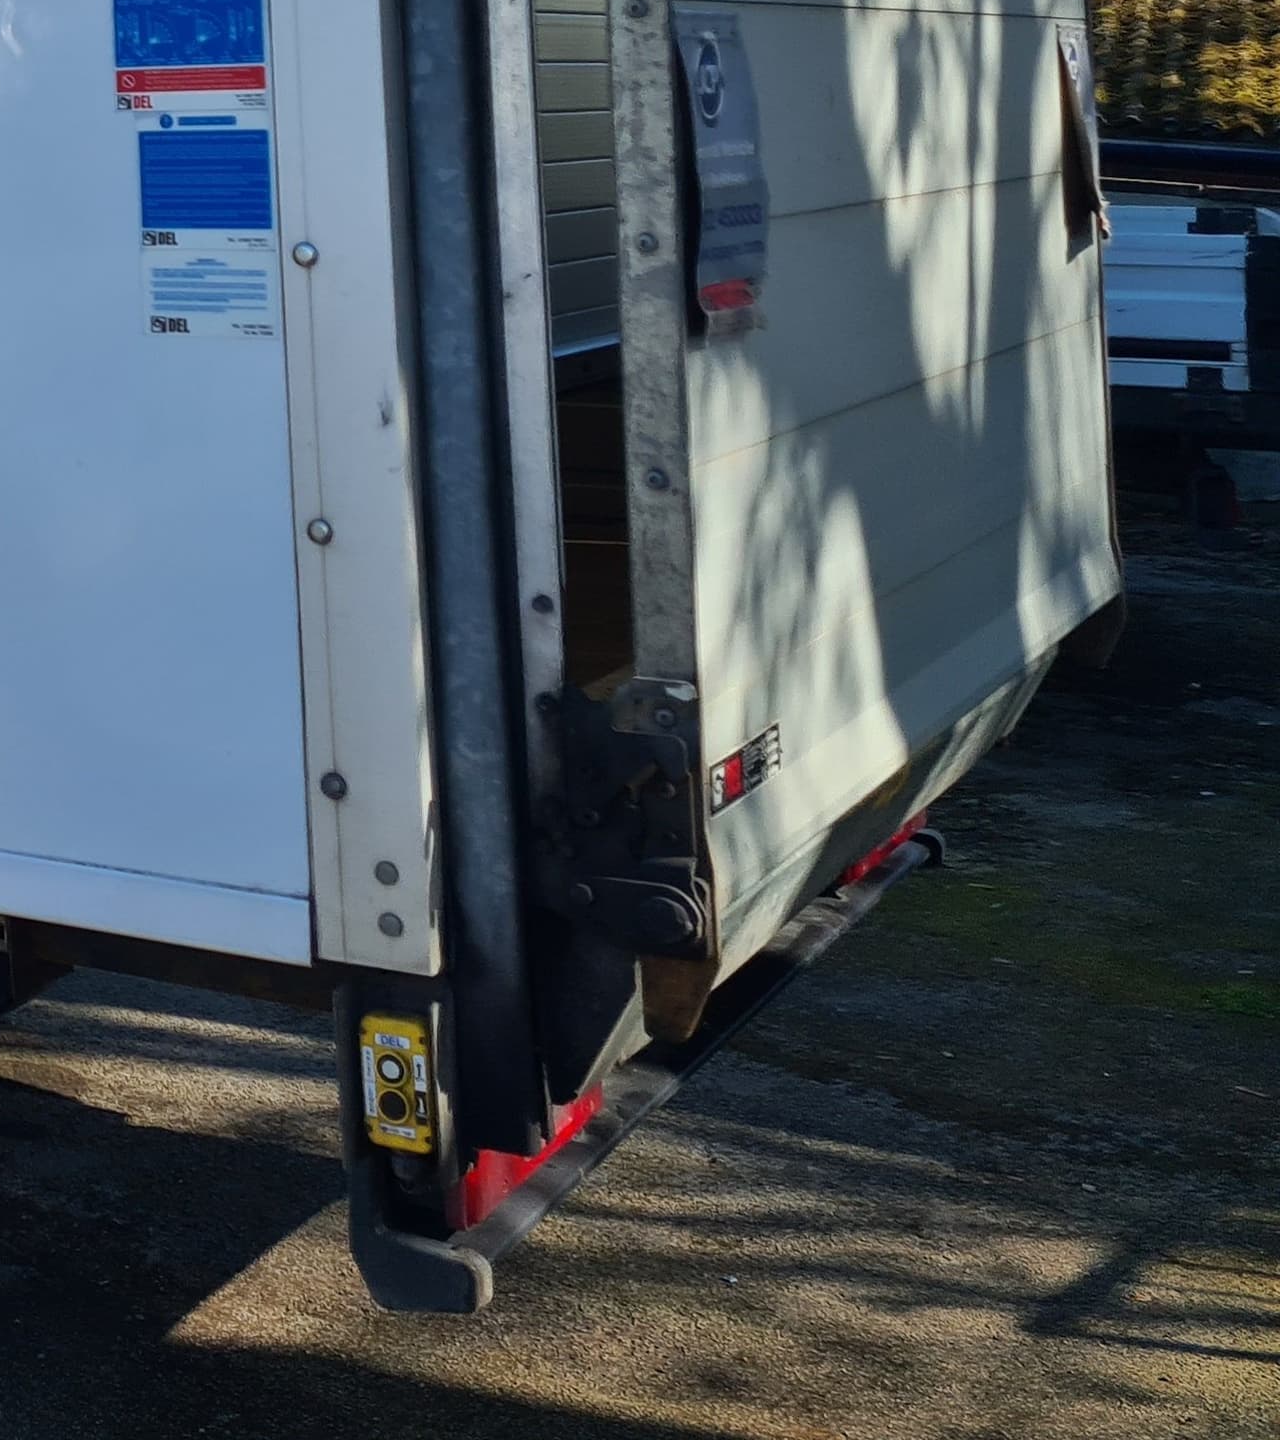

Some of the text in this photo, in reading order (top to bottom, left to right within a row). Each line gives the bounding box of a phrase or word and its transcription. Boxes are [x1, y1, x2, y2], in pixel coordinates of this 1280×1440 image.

[134, 95, 153, 109] DEL
[158, 231, 178, 246] DEL
[168, 317, 190, 333] DEL
[380, 1034, 405, 1049] DEL
